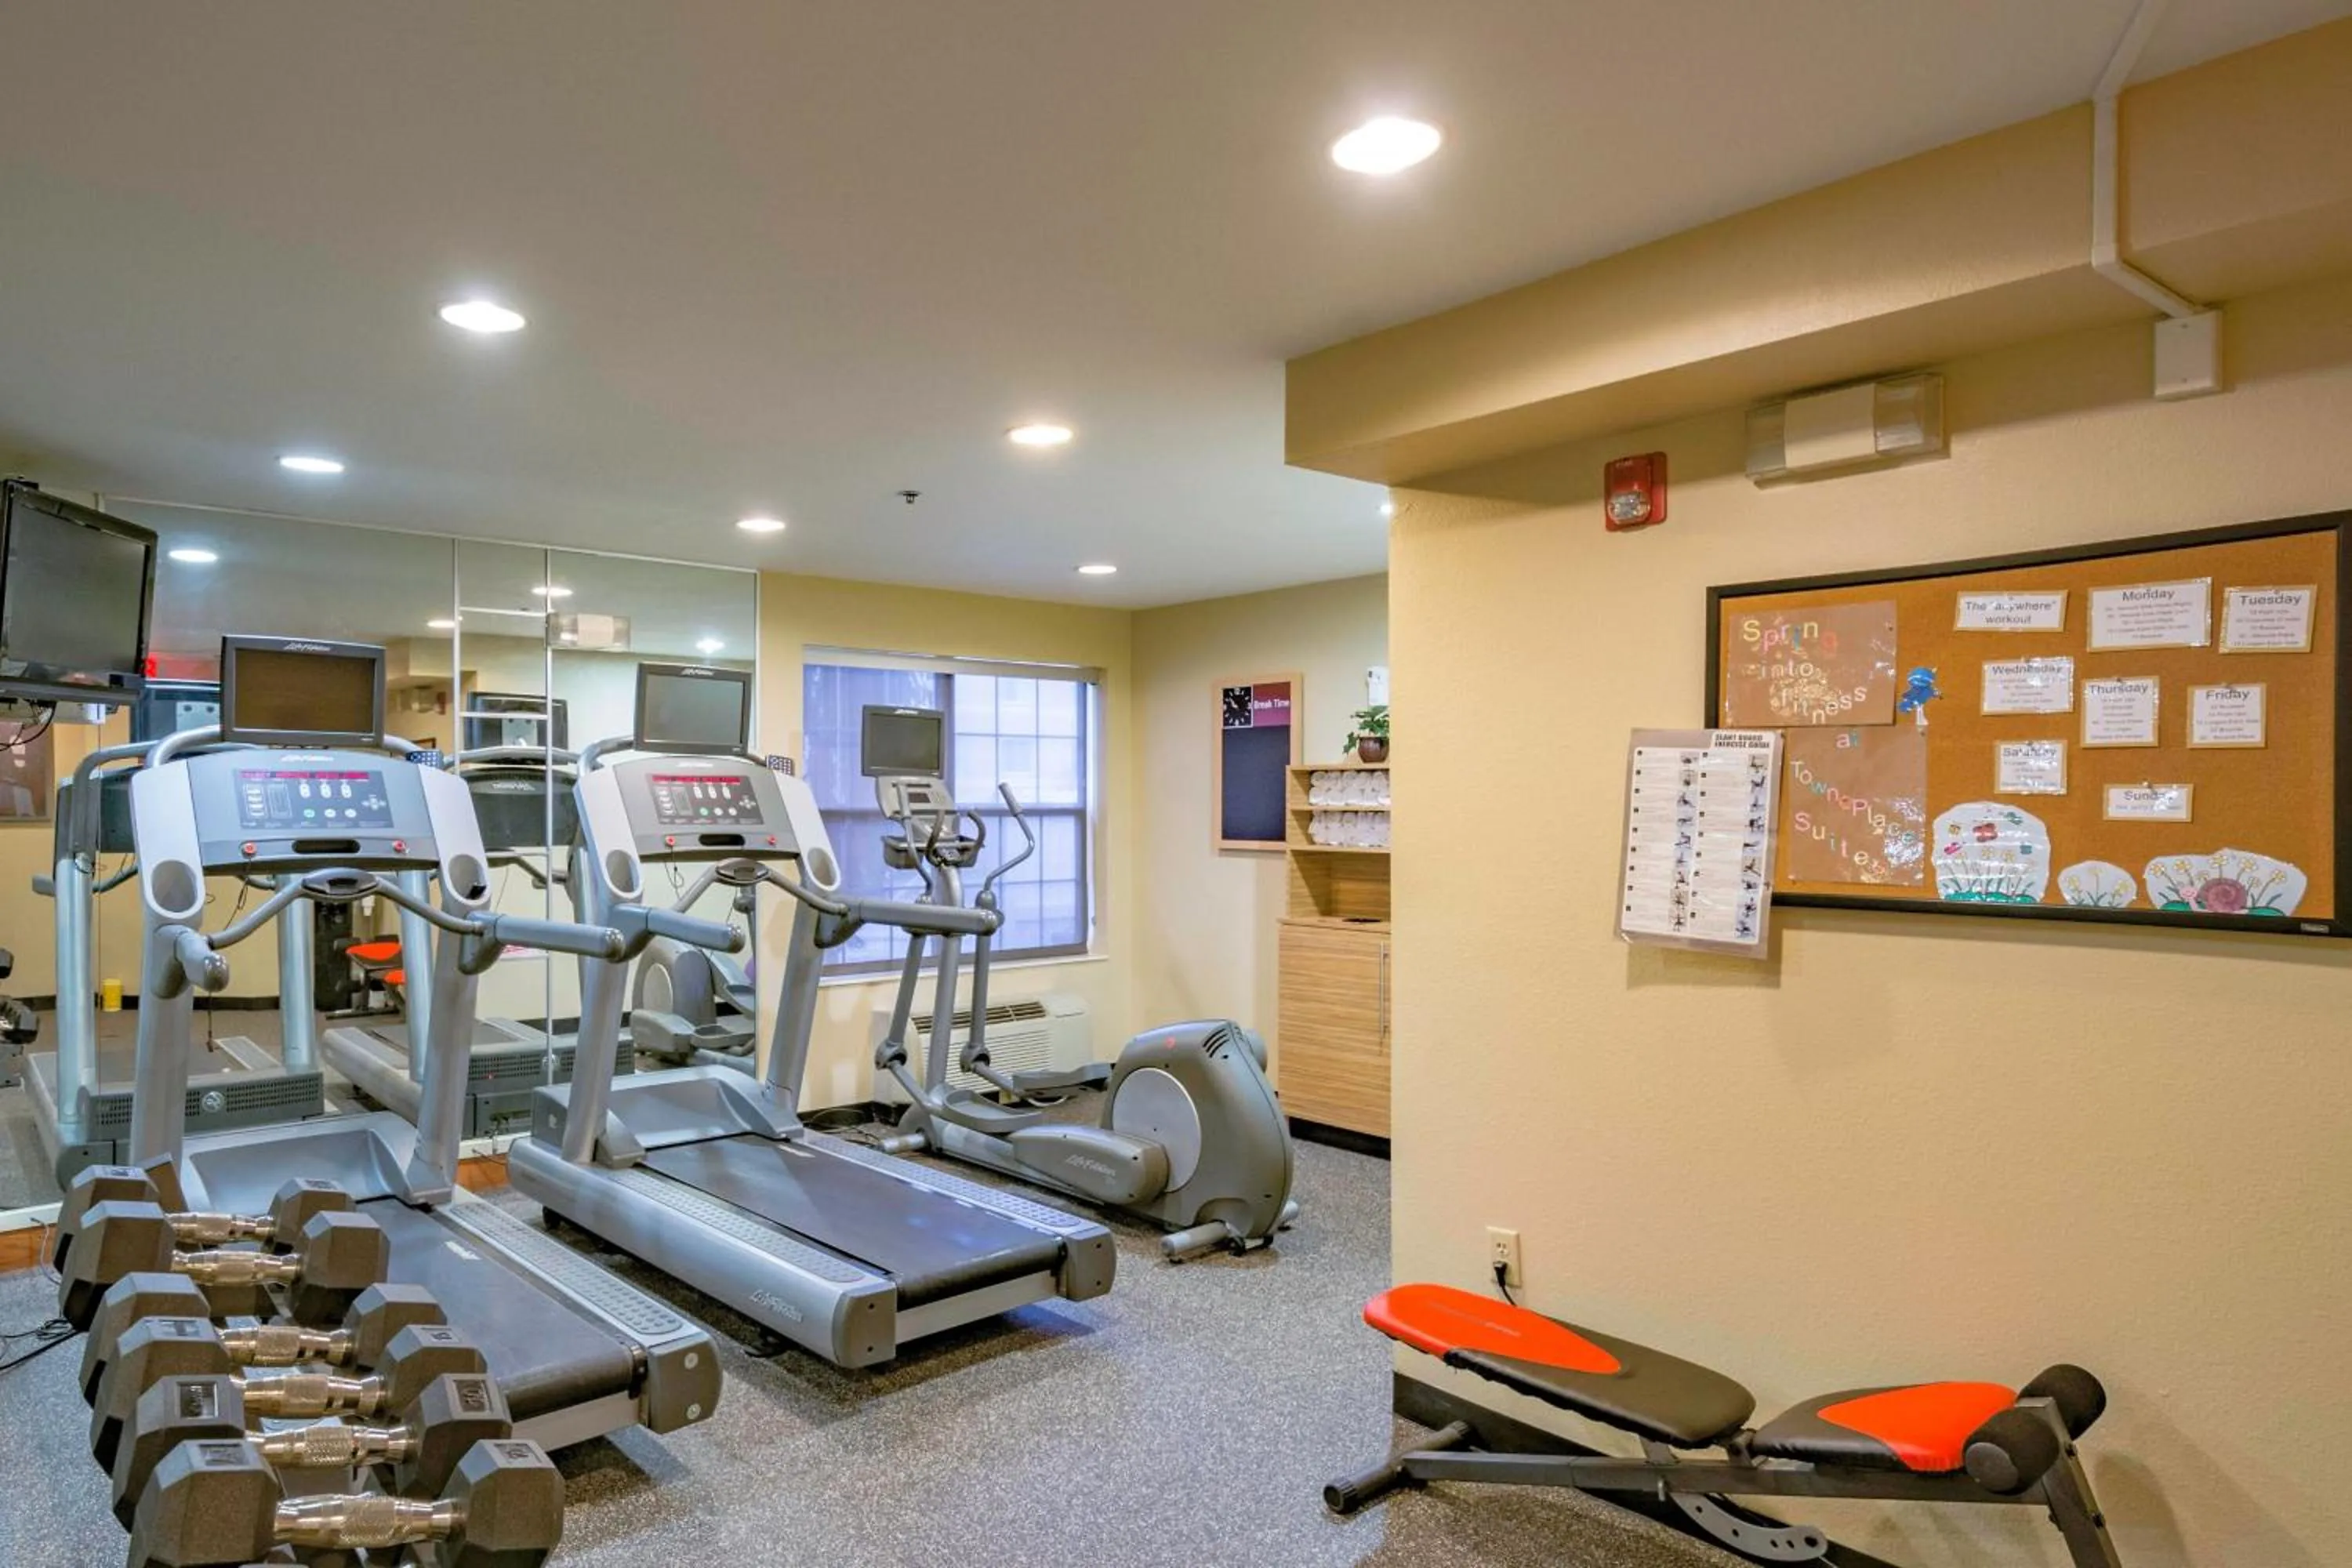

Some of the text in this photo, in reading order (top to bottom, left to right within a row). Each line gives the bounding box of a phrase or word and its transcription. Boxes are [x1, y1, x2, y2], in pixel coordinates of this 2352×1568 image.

[2122, 589, 2176, 602] Monday
[2240, 593, 2303, 606] Tuesday
[1965, 601, 1987, 611] The
[1985, 615, 2031, 624] workout
[2089, 683, 2149, 695] Thursday
[2205, 689, 2251, 701] Friday
[1254, 699, 1290, 710] Break Time
